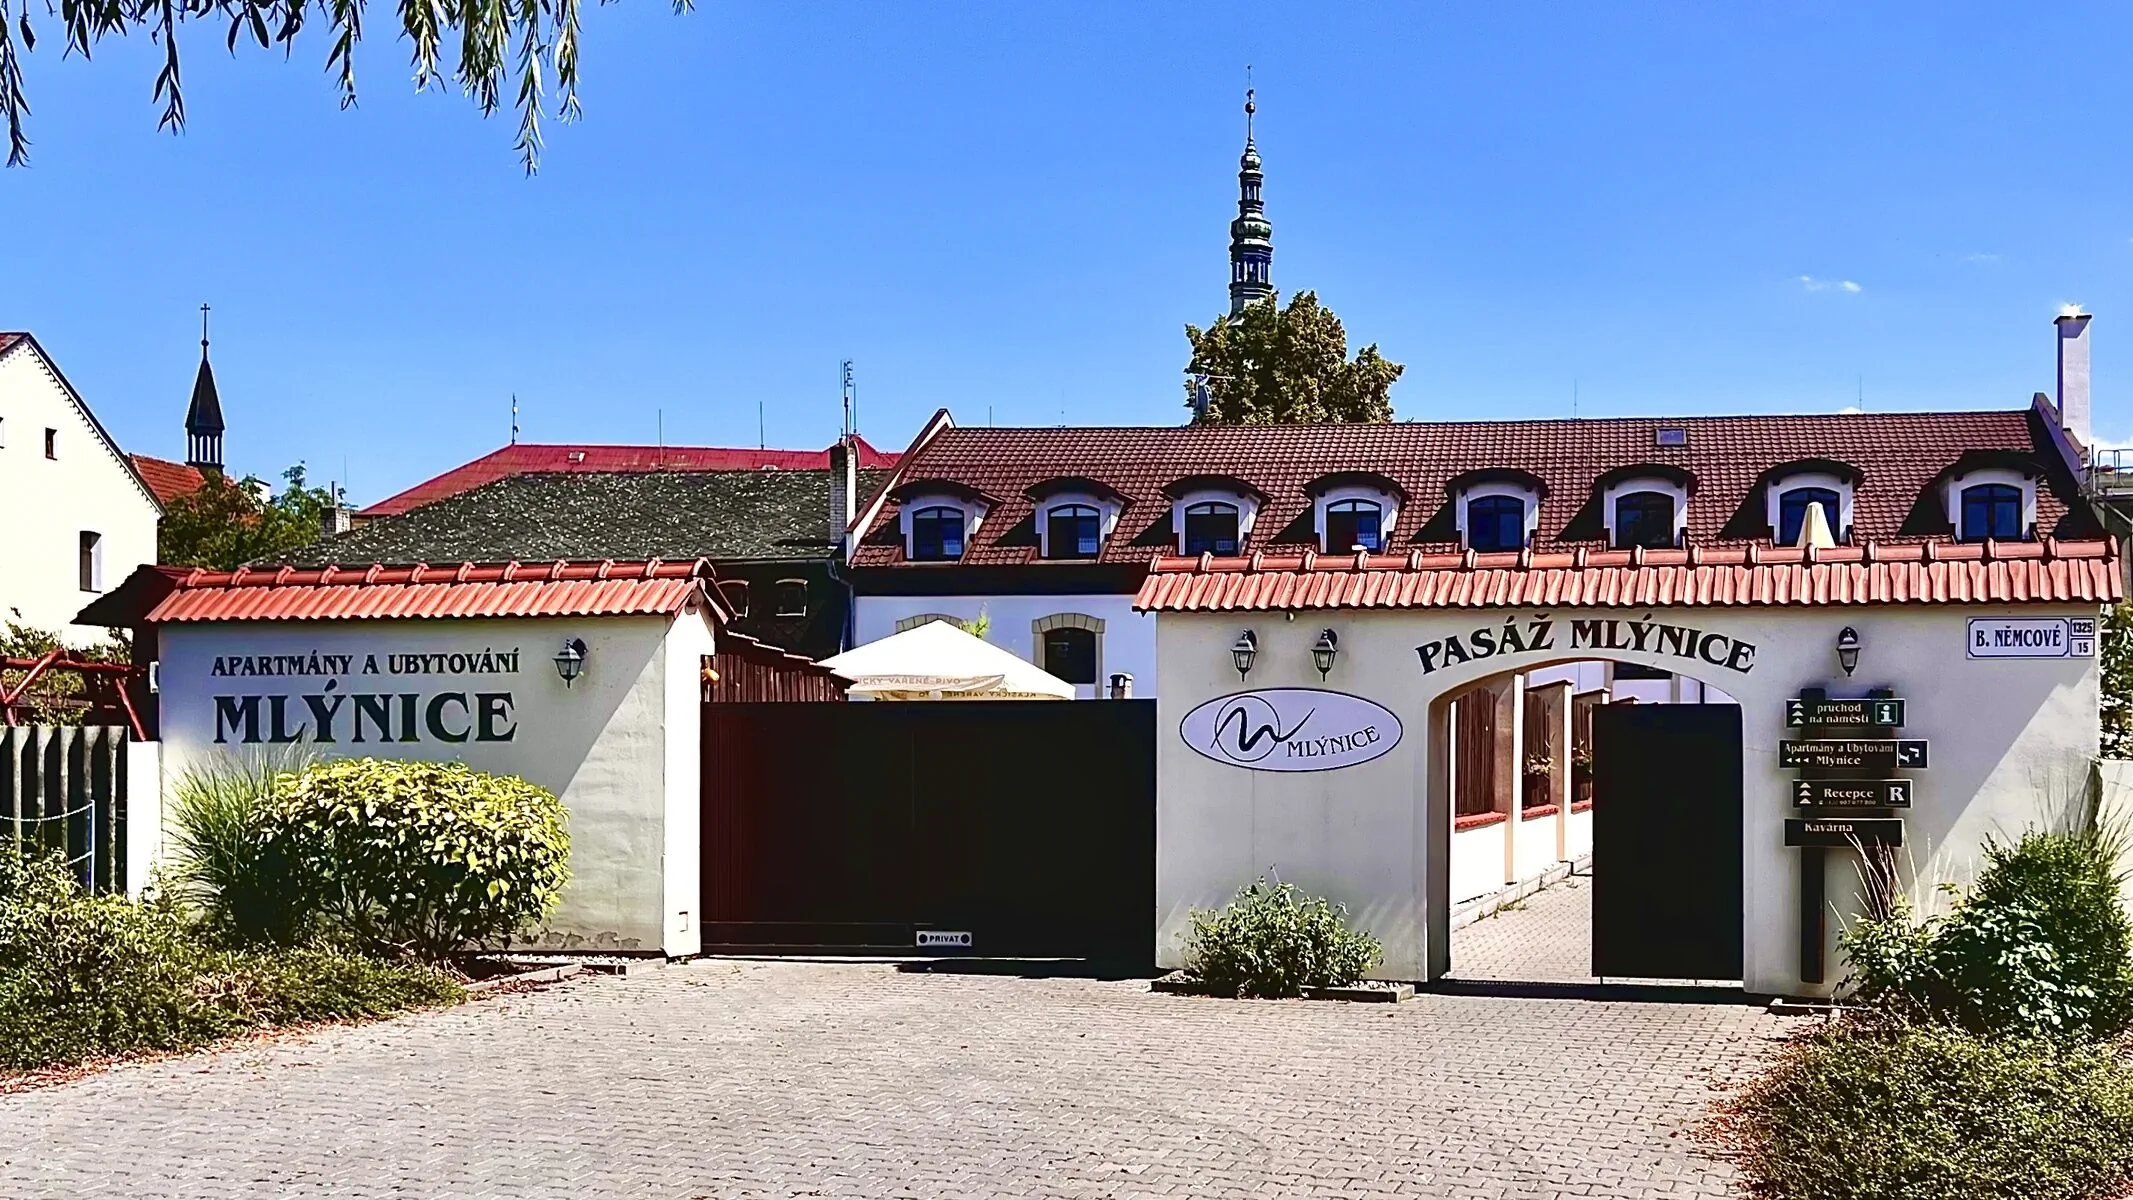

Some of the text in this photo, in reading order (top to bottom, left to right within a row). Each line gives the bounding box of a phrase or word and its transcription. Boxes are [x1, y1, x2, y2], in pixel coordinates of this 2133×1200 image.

[2072, 622, 2093, 634] 1325
[1976, 625, 2061, 647] B. NĚMCOVÉ
[1414, 612, 1757, 676] PASÁŽ MLÝNICE
[2078, 643, 2088, 653] 15
[211, 647, 520, 677] APARTMÁNY A UBYTOVÁNÍ
[213, 678, 519, 744] MLÝNICE
[1809, 715, 1823, 724] na
[1287, 726, 1380, 757] MLÝNICE
[1838, 745, 1844, 753] a
[1824, 788, 1874, 799] Recepce
[1889, 786, 1905, 801] R
[1804, 822, 1853, 832] Kavárna
[929, 935, 959, 943] PRIVAT
